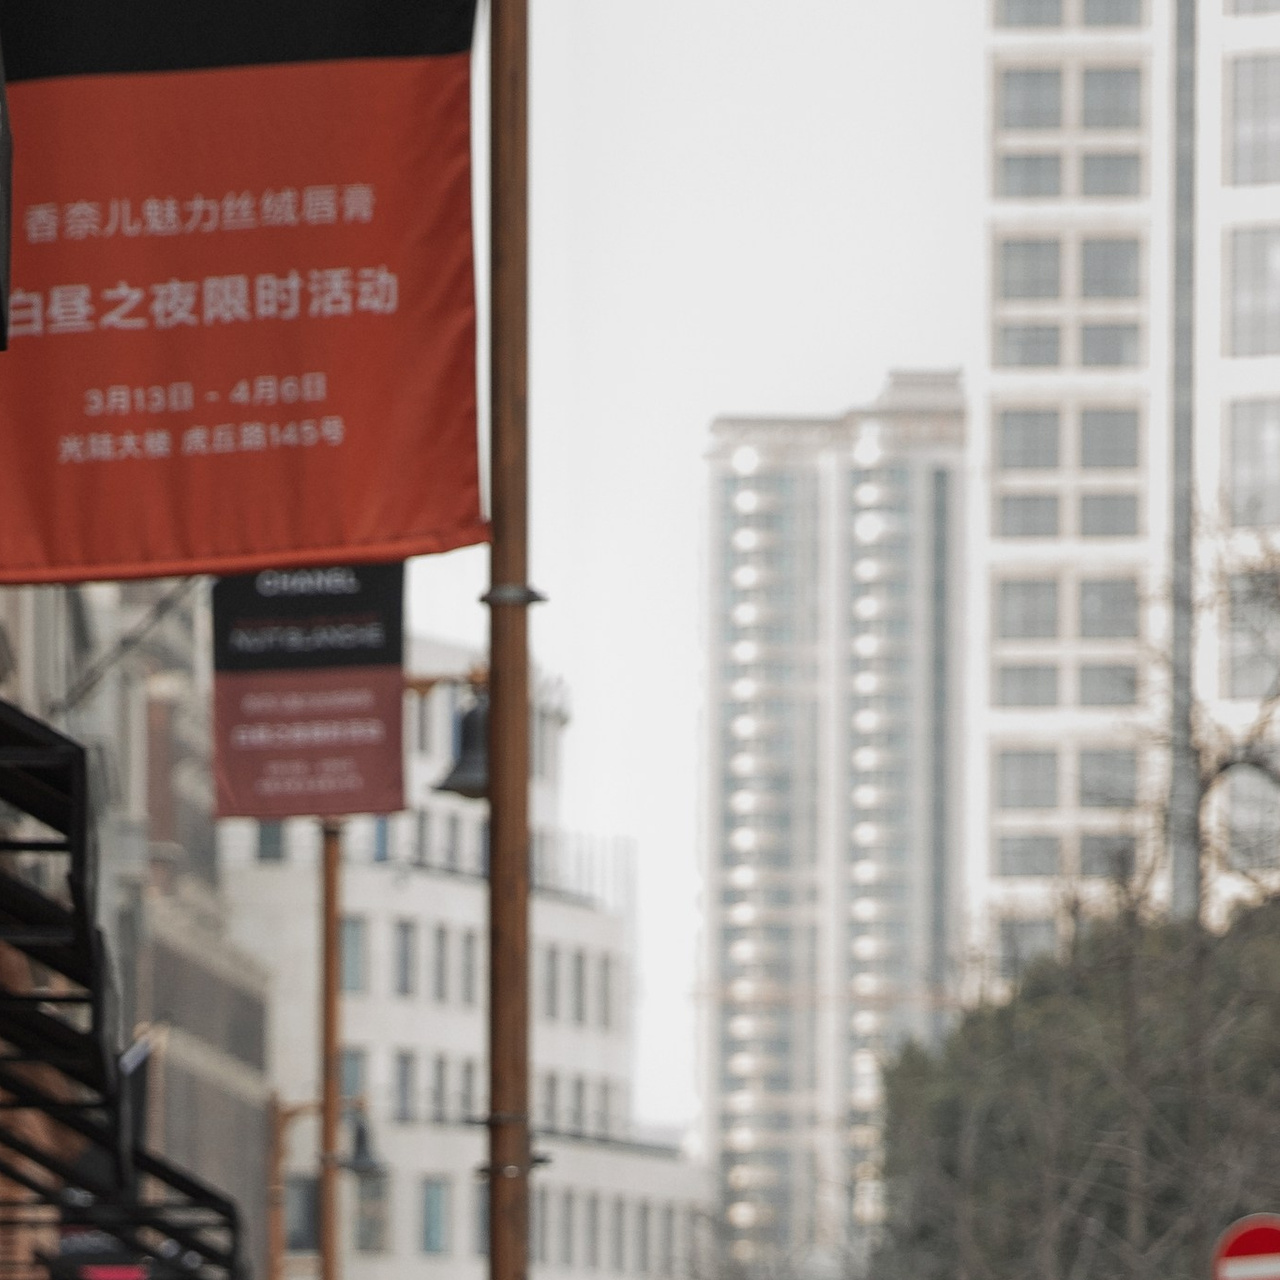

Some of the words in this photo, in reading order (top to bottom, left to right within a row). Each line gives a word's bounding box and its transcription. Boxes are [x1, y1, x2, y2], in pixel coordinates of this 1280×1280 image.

[25, 183, 374, 243] 香奈儿魅力丝绒唇膏
[8, 265, 398, 337] 白昼之夜限时活动
